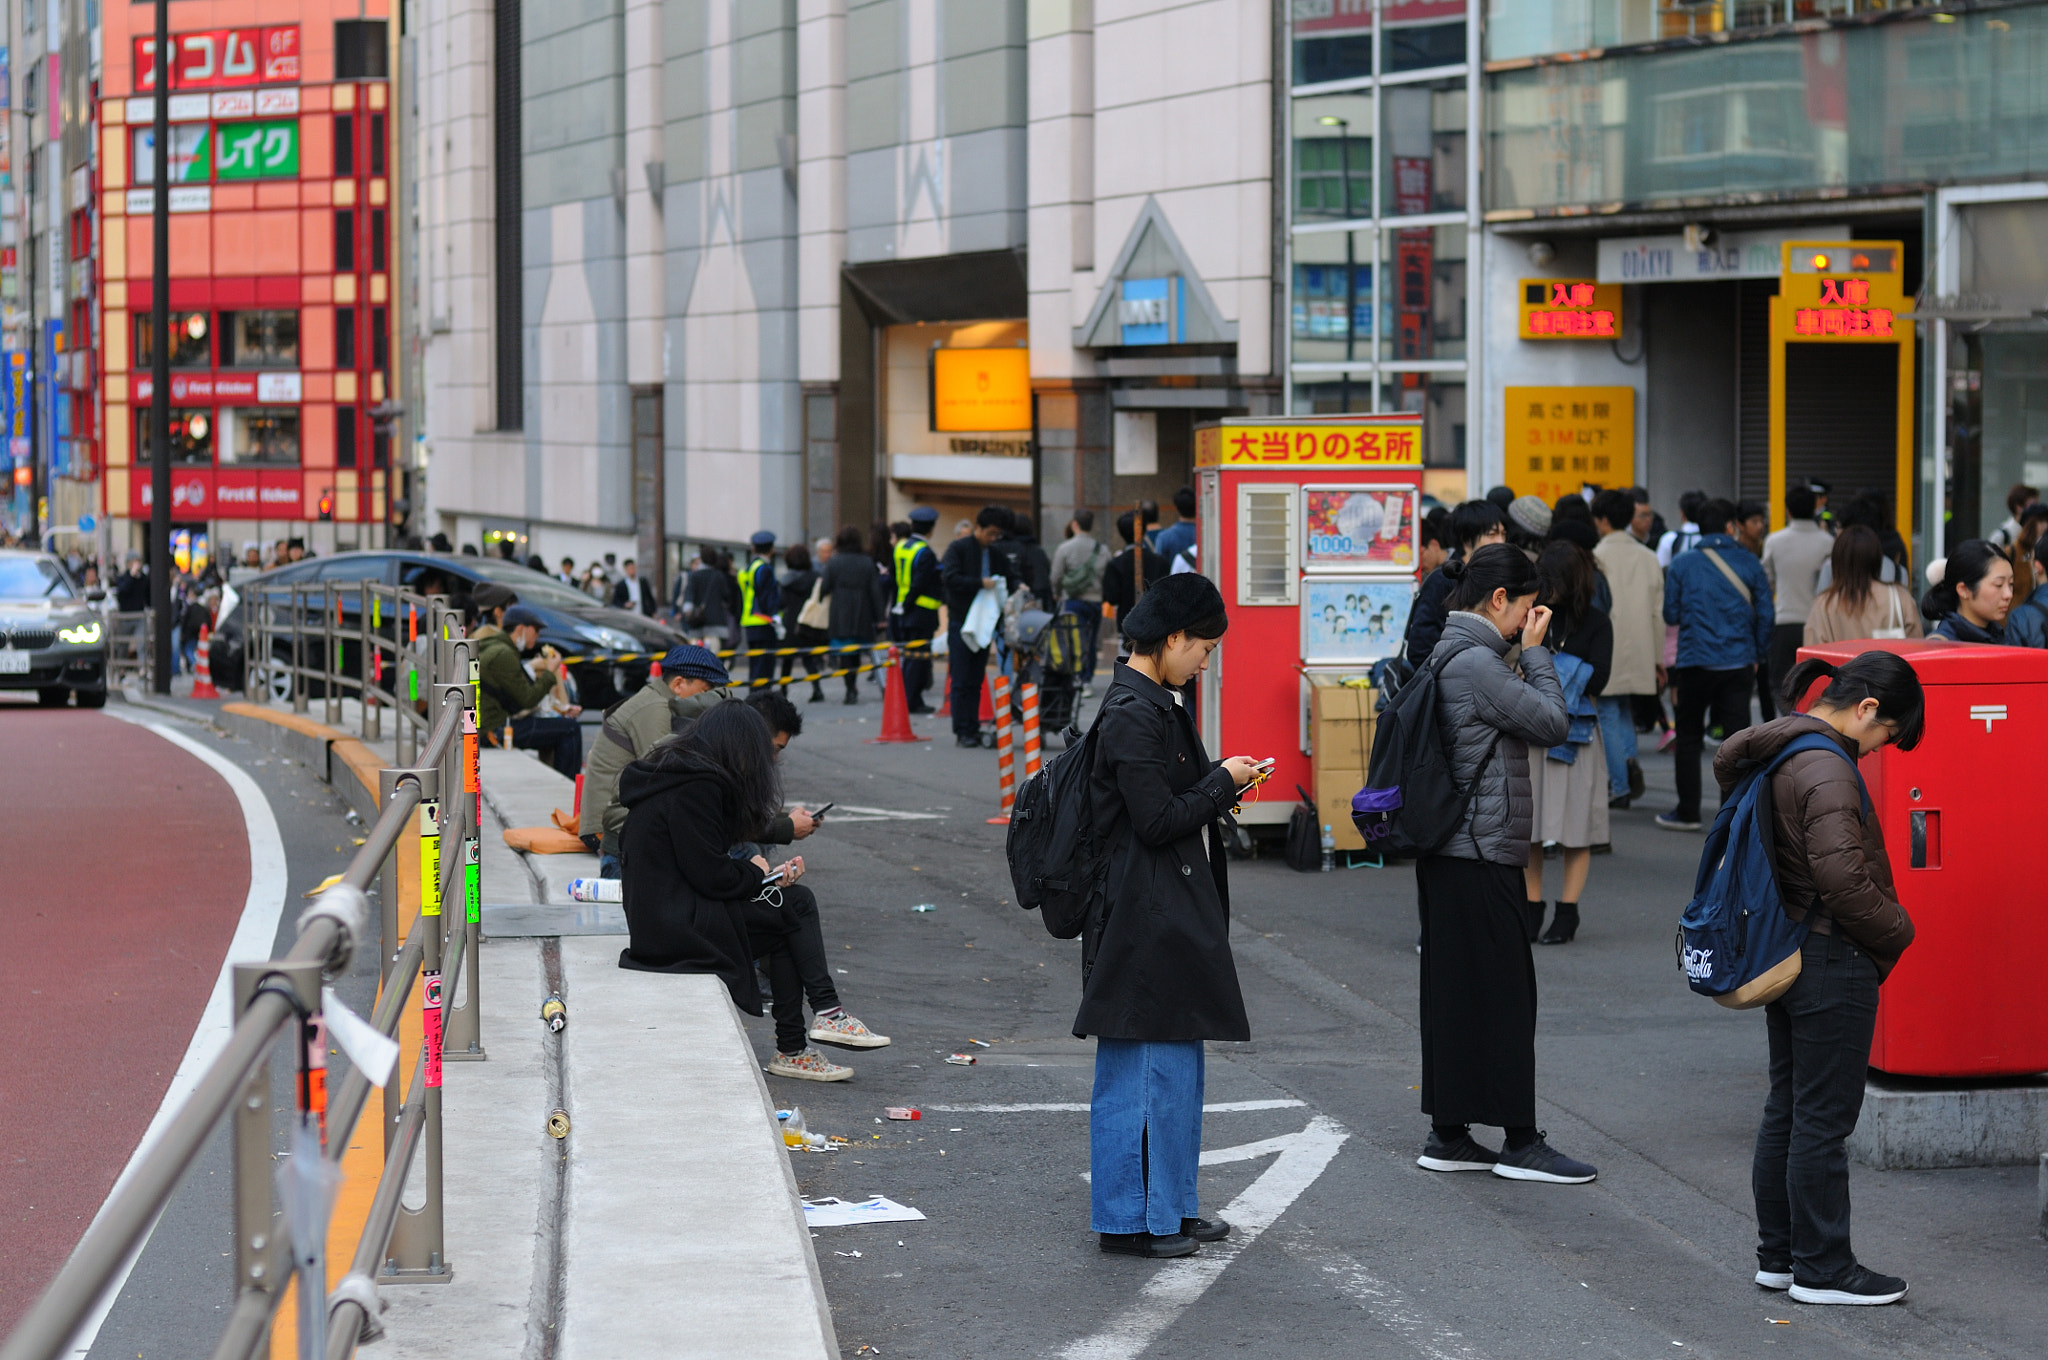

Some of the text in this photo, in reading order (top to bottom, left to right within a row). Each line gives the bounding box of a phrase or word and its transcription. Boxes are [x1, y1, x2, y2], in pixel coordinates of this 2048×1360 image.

[216, 128, 291, 170] レイク
[1550, 283, 1595, 308] 入庫
[1820, 278, 1869, 306] 入庫
[1528, 402, 1610, 419] 高さ制限
[1230, 431, 1413, 461] 大当りの名所
